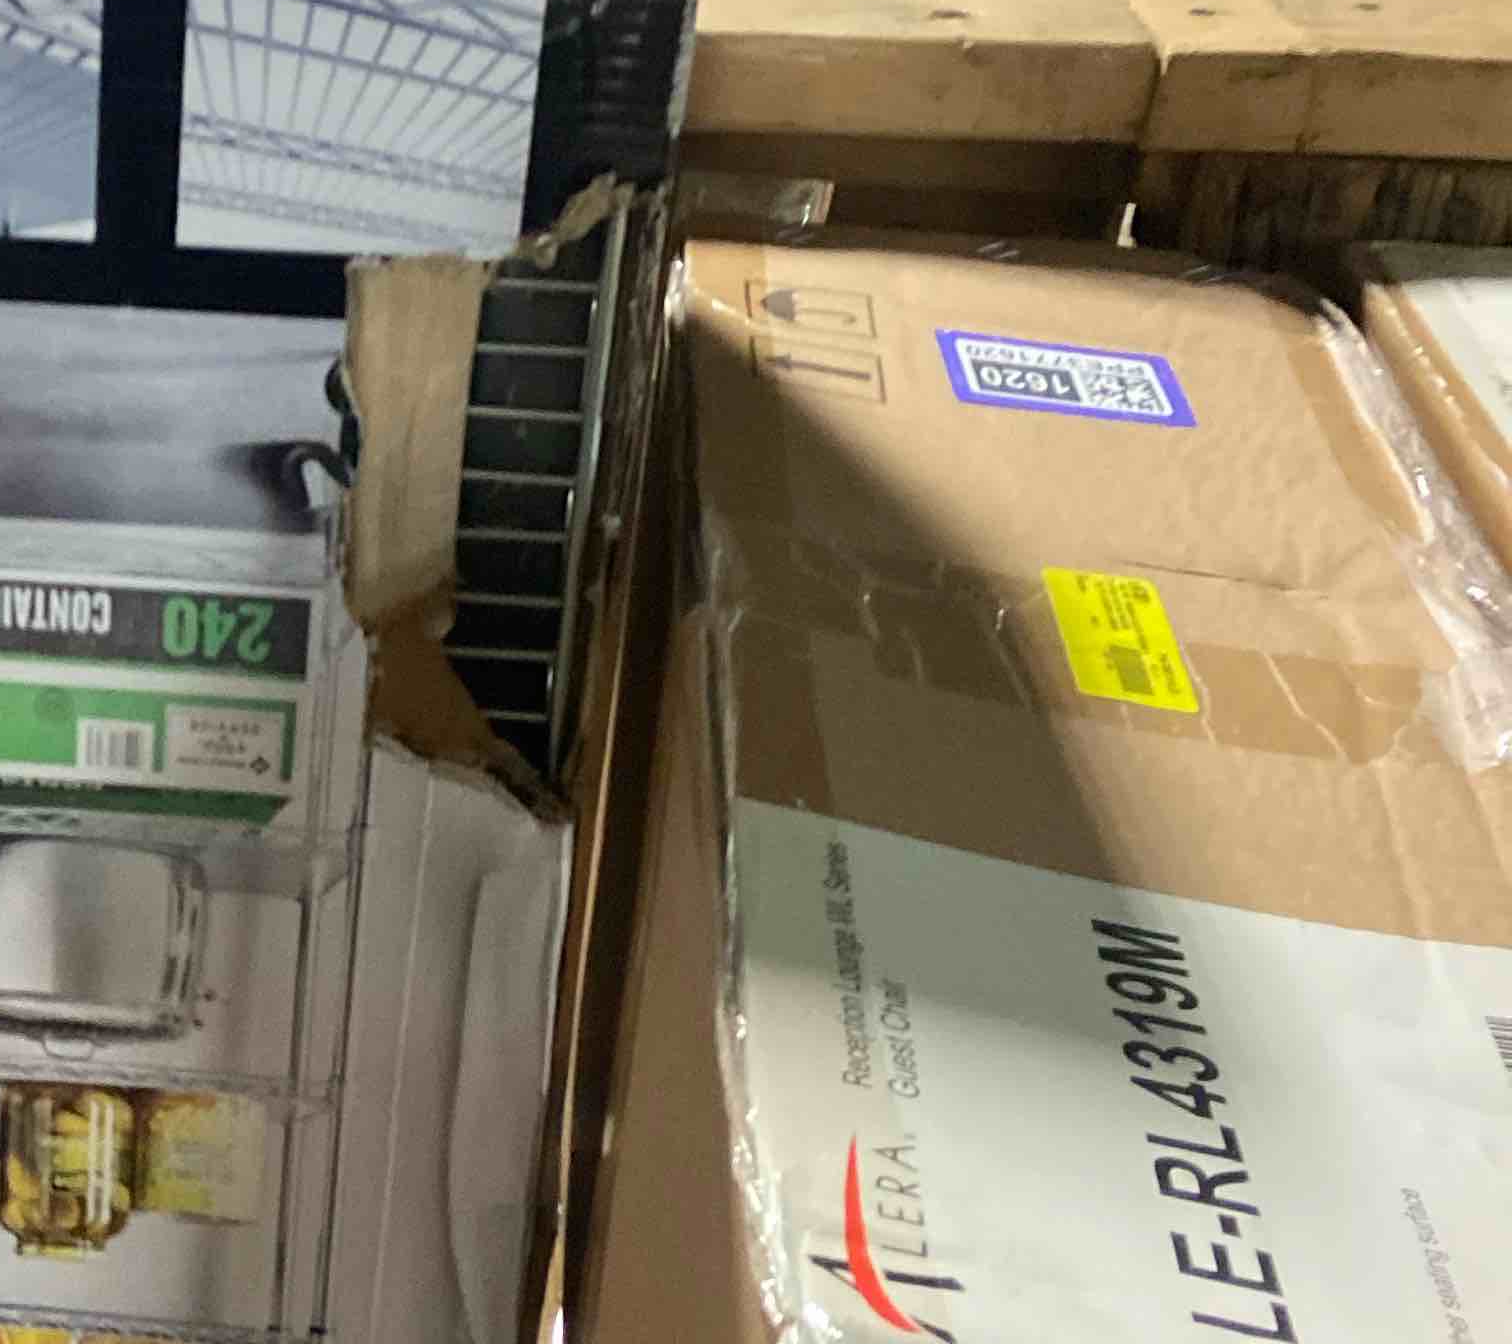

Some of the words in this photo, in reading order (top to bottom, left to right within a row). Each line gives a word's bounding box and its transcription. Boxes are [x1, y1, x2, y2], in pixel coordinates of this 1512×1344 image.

[979, 364, 1071, 396] 1620
[161, 597, 275, 663] 240
[826, 929, 865, 993] Lounge
[878, 978, 913, 1033] Chair
[836, 995, 874, 1088] Reception
[883, 1035, 922, 1100] Guest
